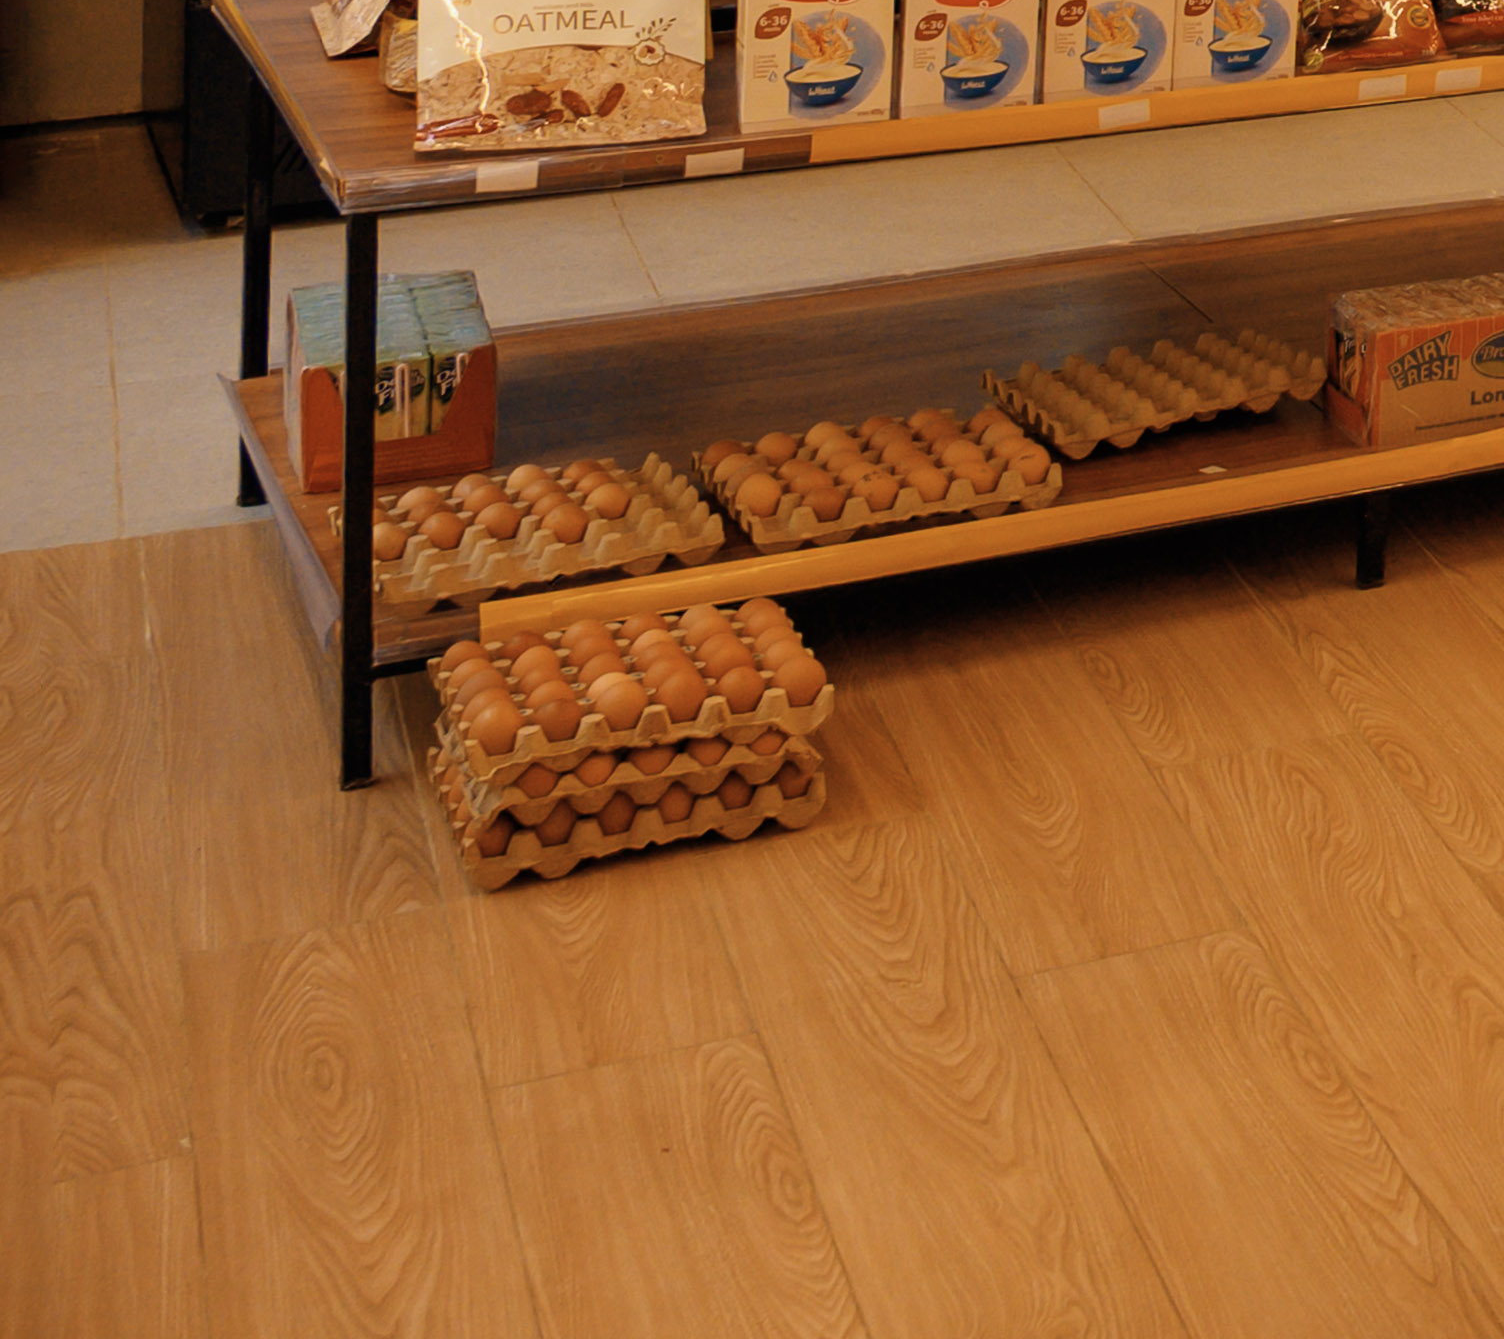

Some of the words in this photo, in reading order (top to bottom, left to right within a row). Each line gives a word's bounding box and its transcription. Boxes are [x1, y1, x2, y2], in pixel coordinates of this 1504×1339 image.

[492, 7, 634, 36] OATMEAL
[759, 15, 789, 31] 6-36
[1060, 5, 1085, 18] 6-36
[1389, 331, 1452, 378] DAIRY
[1396, 355, 1458, 389] FRESH
